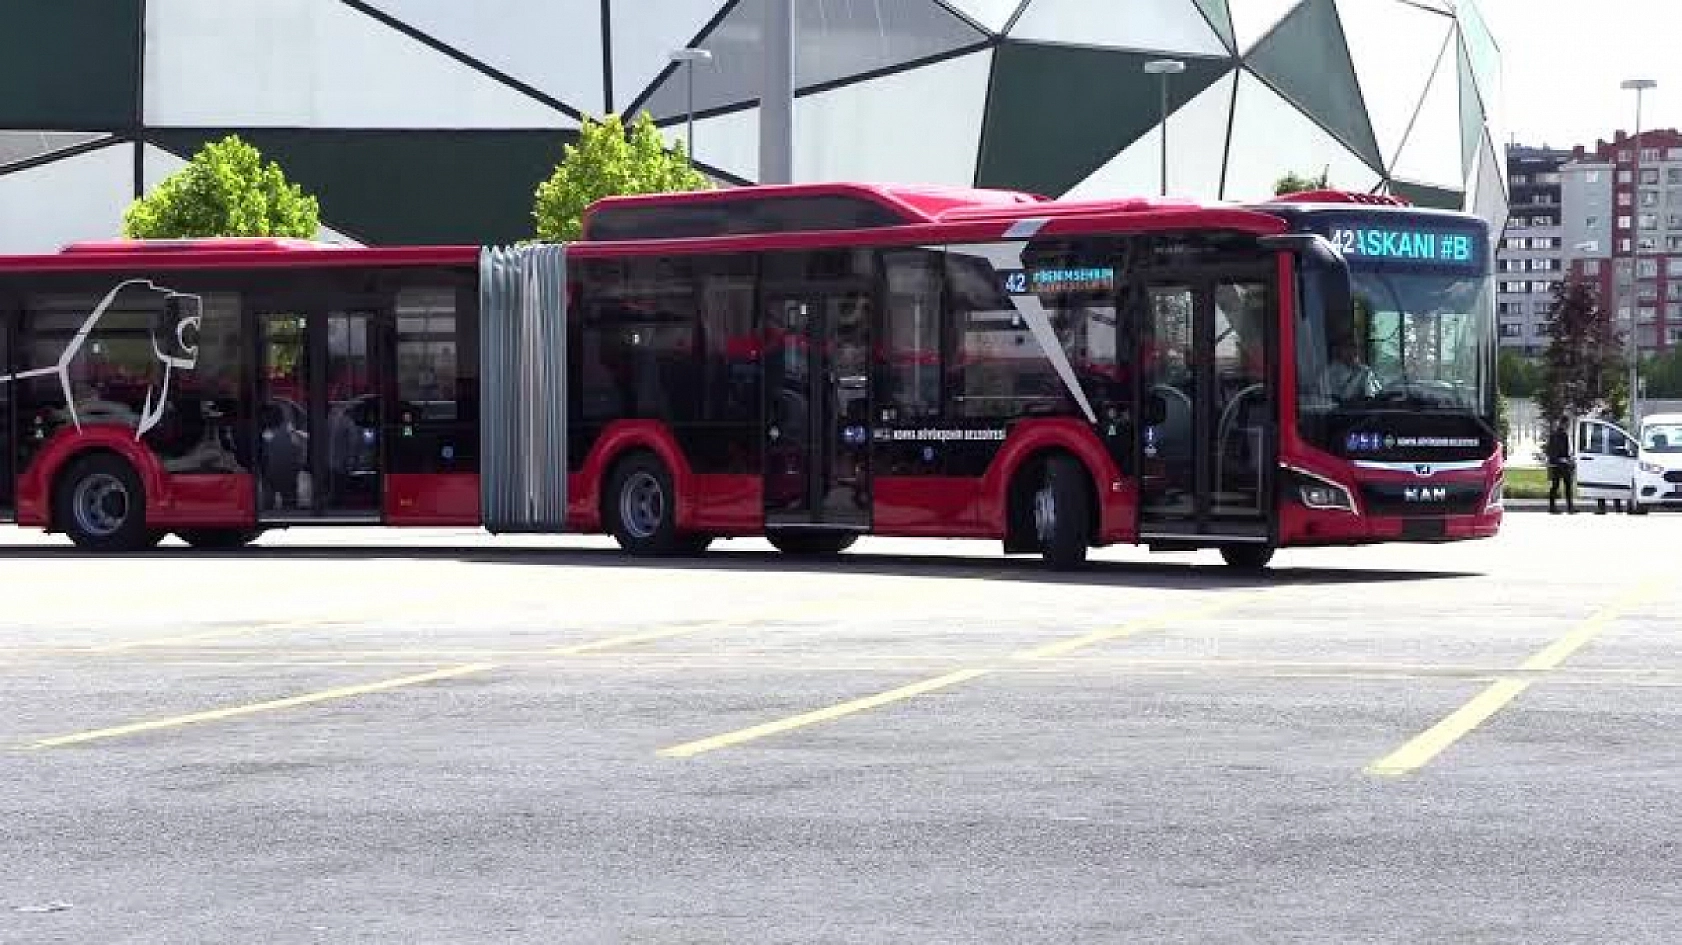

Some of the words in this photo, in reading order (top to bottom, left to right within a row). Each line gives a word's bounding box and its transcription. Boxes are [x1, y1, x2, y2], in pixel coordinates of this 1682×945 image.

[1333, 230, 1355, 253] 42
[1441, 234, 1469, 260] #B
[1005, 272, 1026, 292] 42
